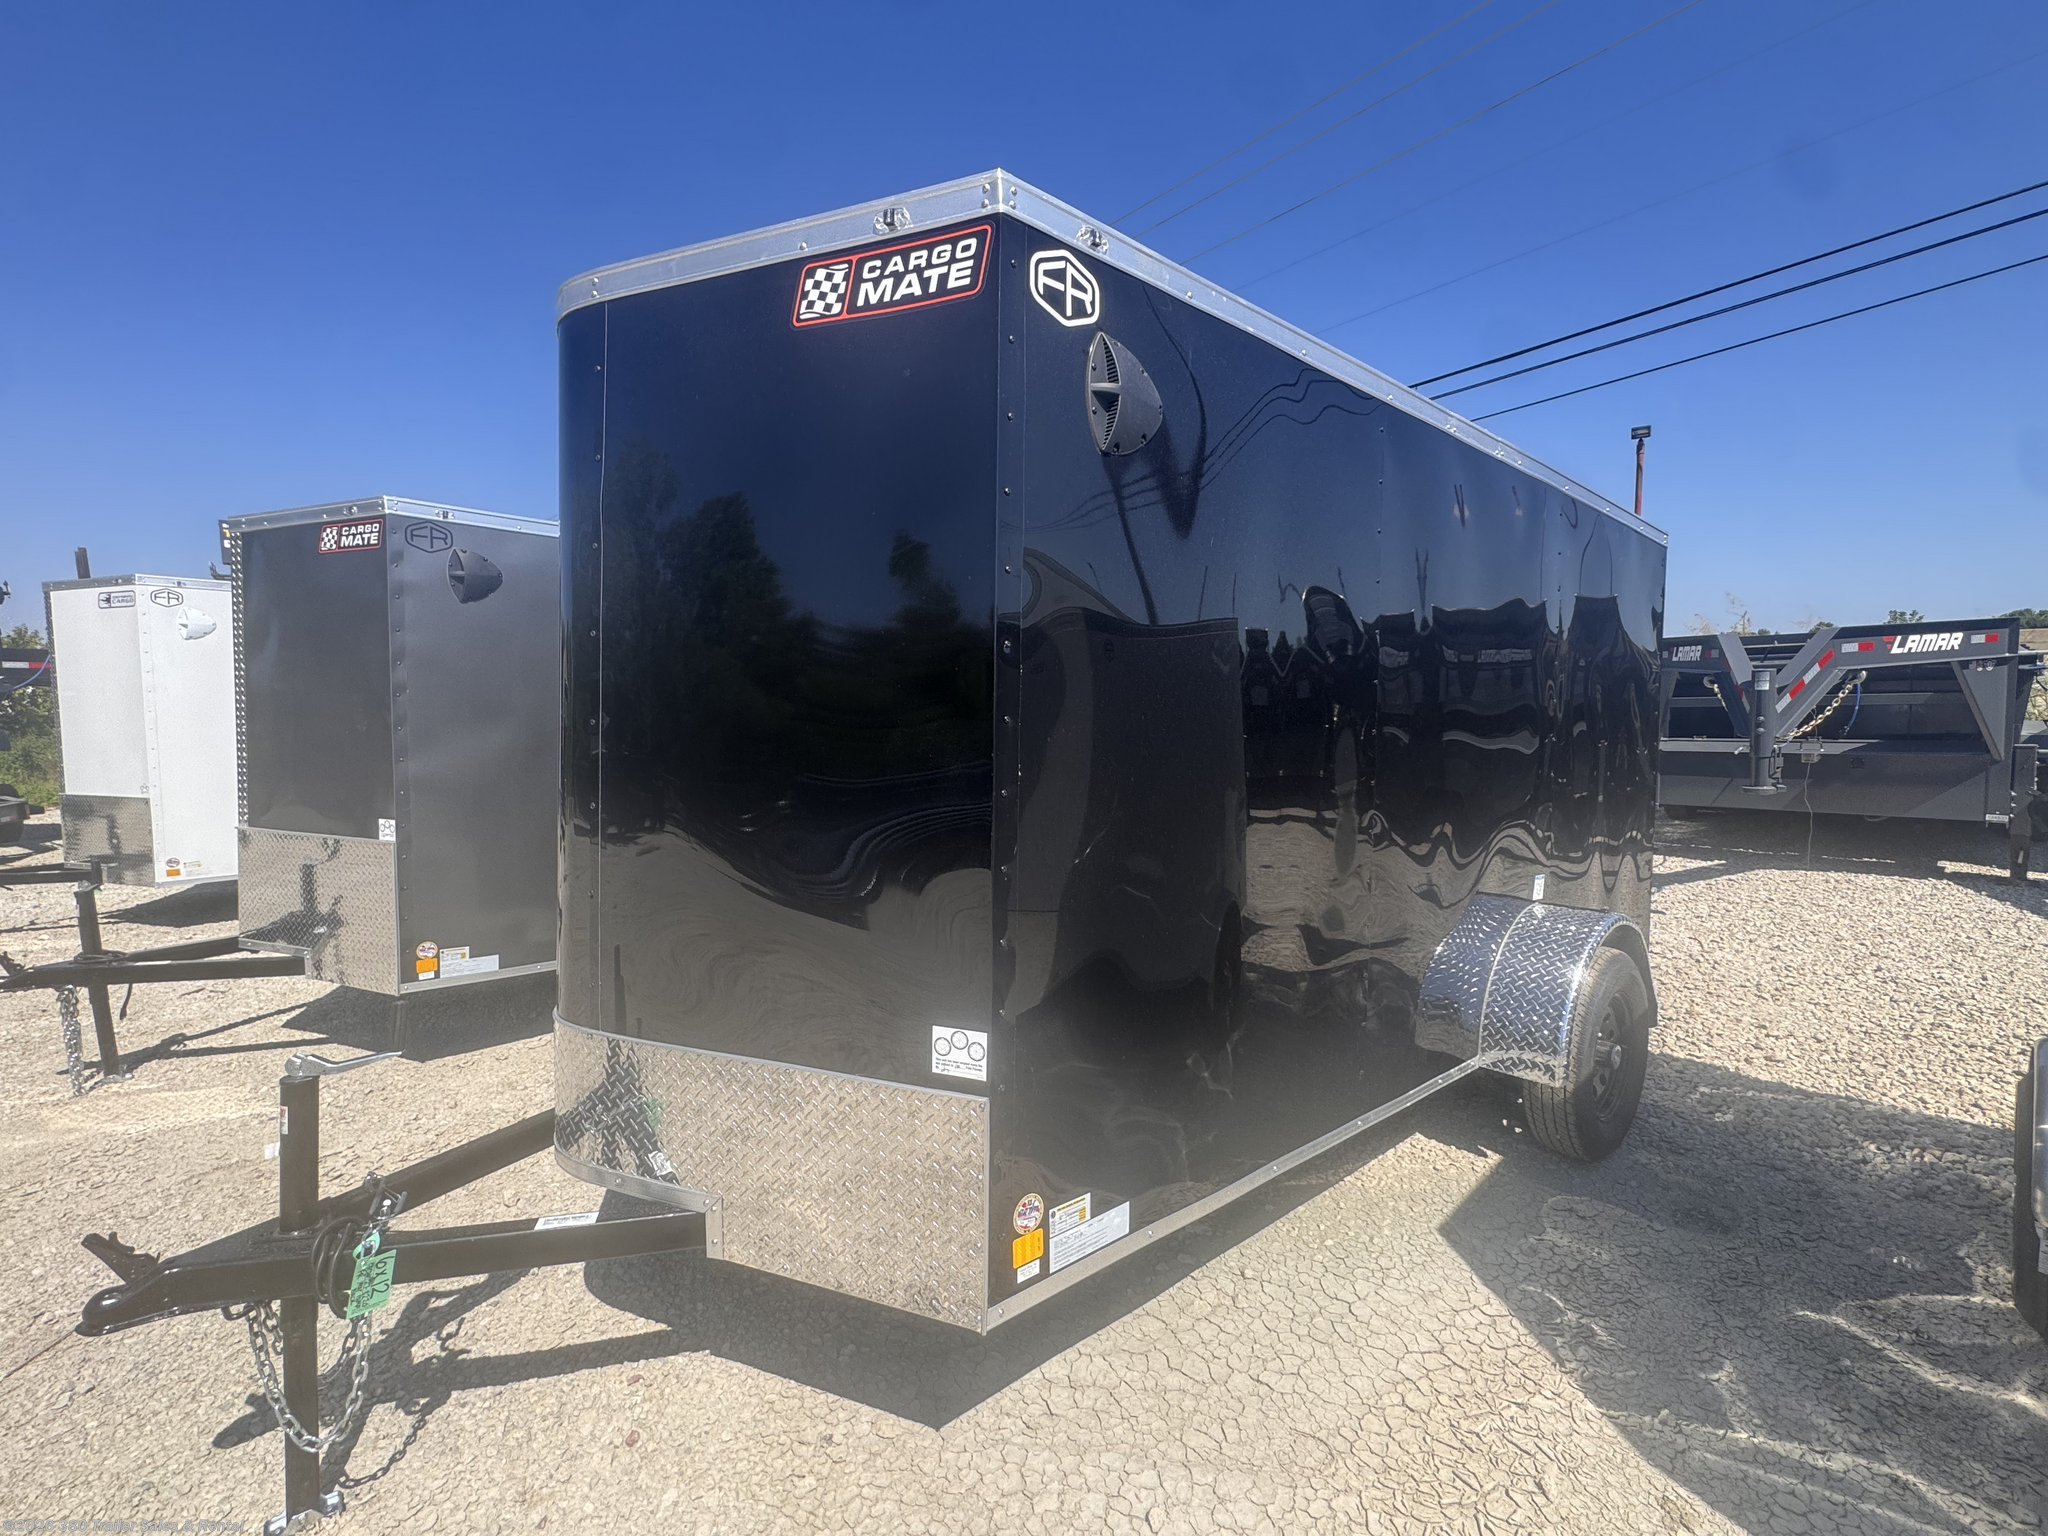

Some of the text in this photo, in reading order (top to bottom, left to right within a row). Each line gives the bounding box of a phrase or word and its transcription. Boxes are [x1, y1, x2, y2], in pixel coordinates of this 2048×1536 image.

[862, 237, 977, 279] CARGO
[856, 259, 974, 307] MATE
[341, 523, 379, 536] CARGO
[340, 532, 379, 547] MATE
[1890, 632, 1963, 654] LAMAR
[1671, 645, 1702, 661] LAMAR
